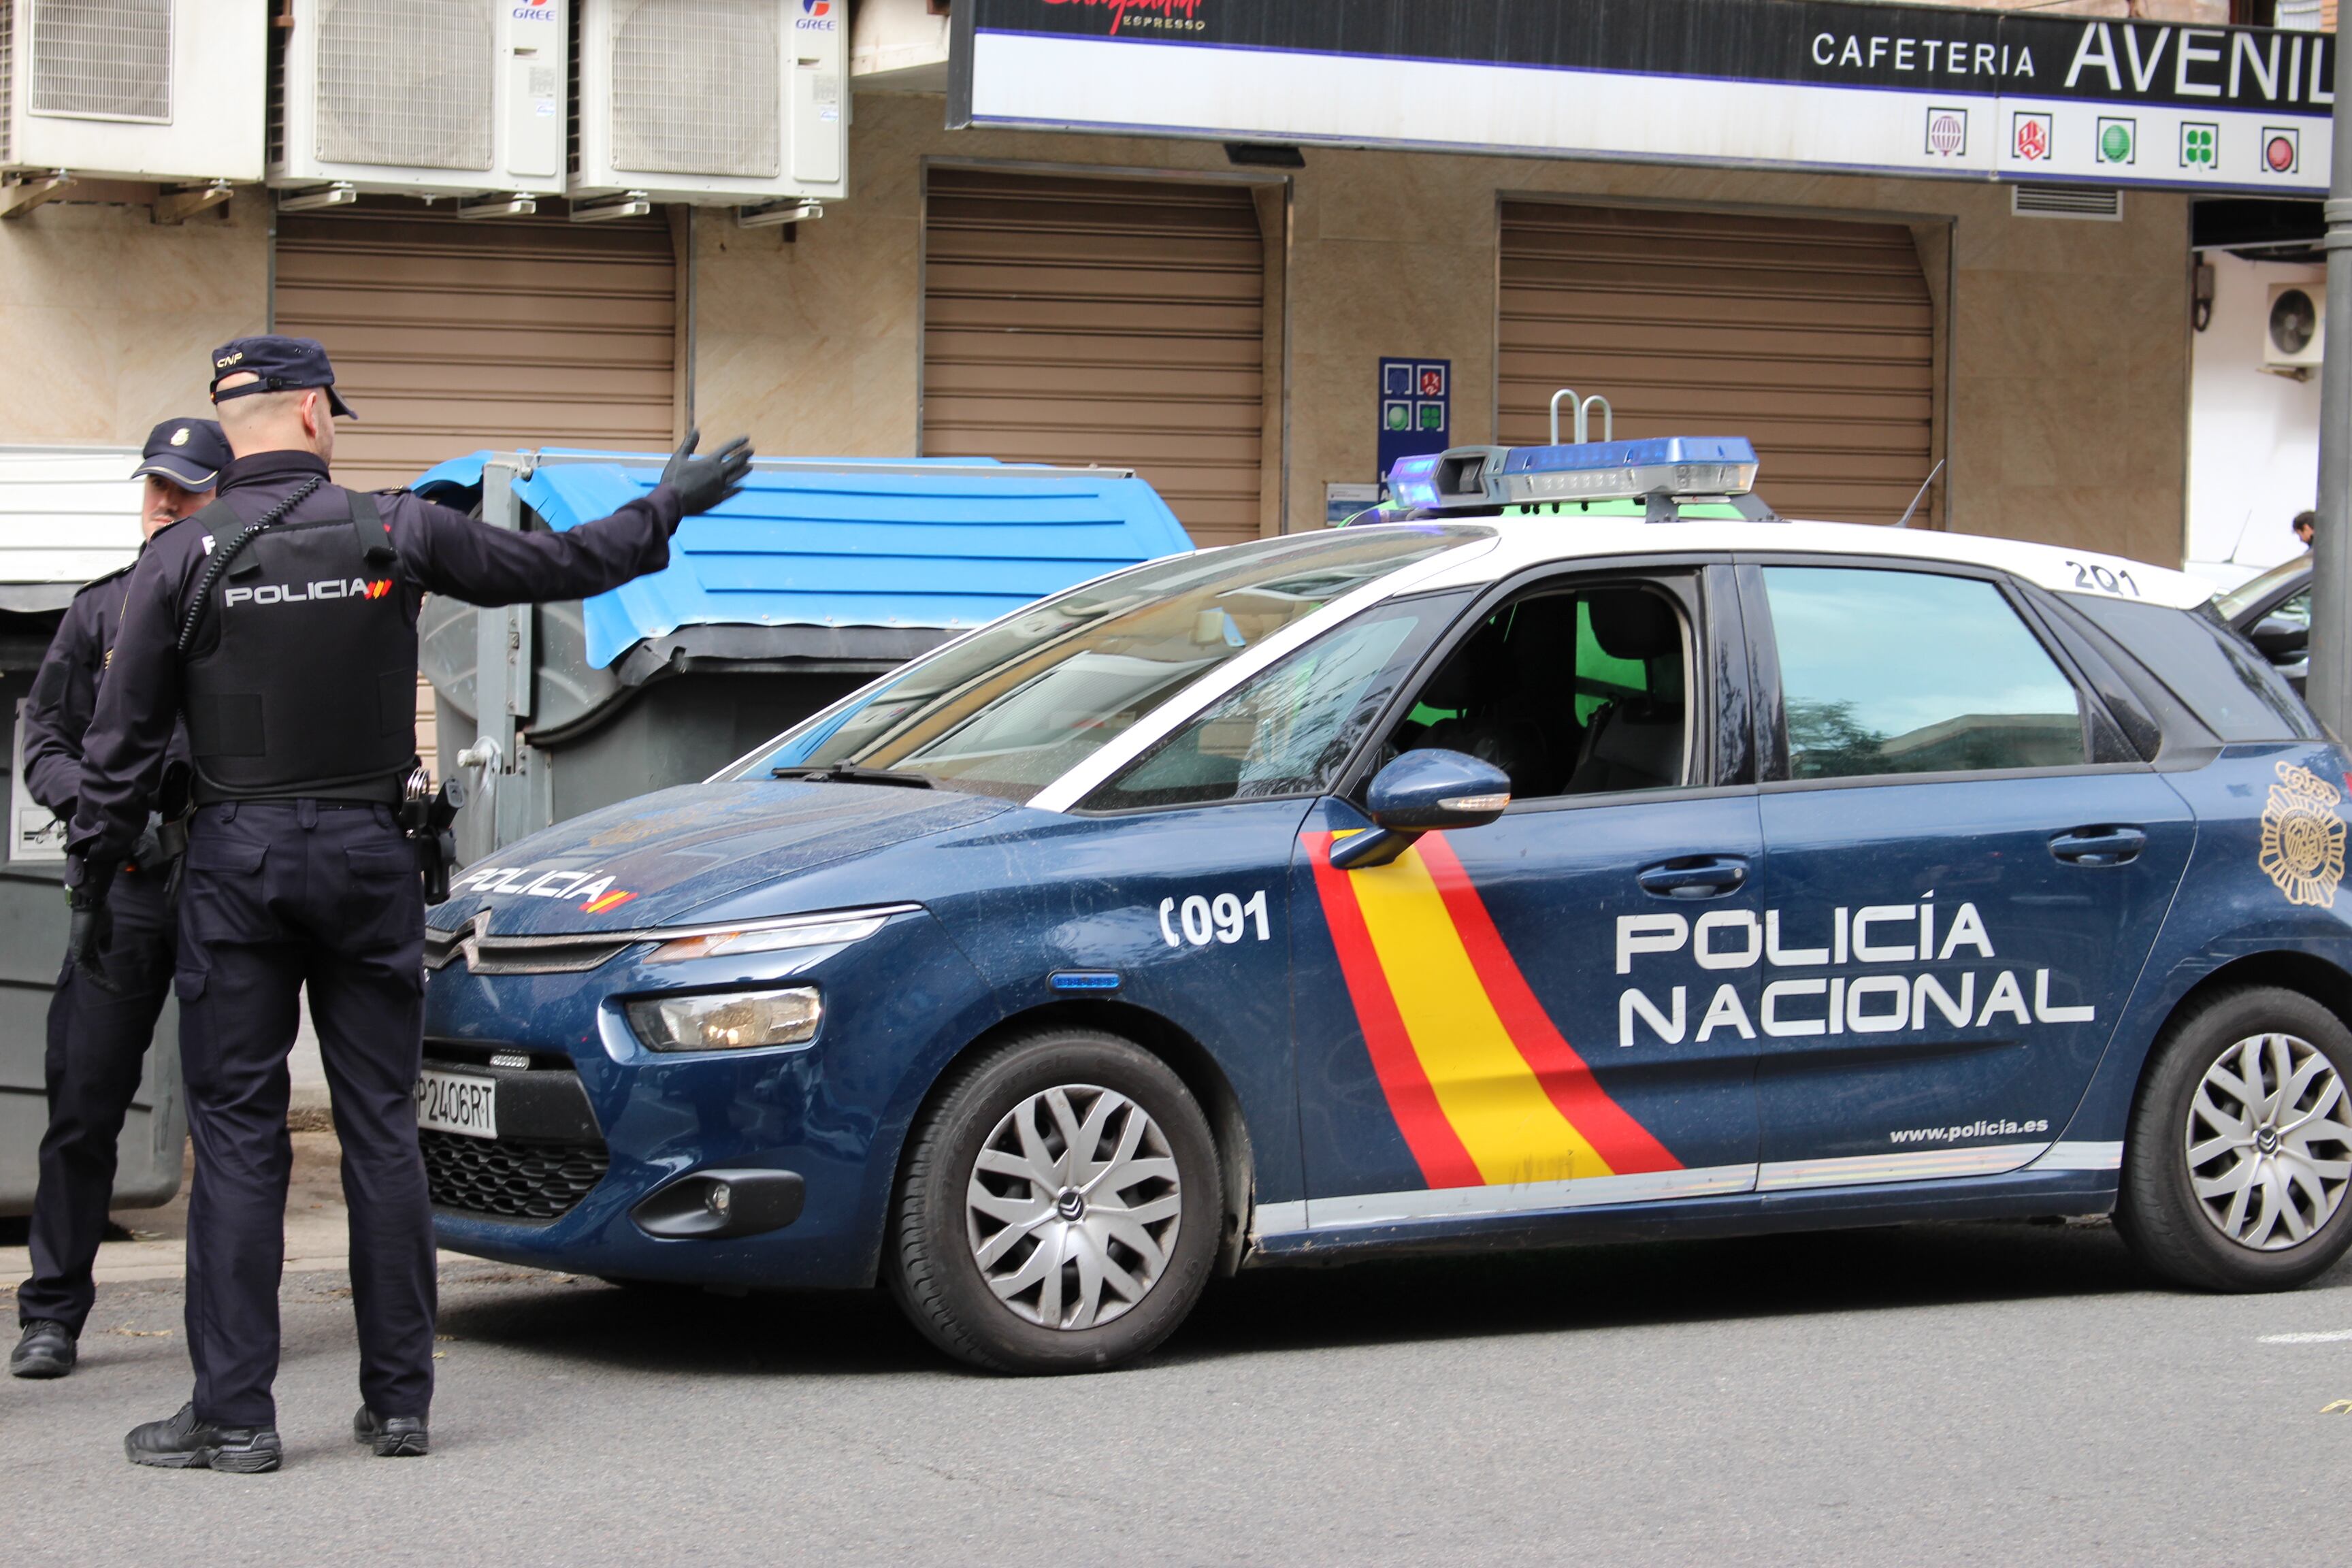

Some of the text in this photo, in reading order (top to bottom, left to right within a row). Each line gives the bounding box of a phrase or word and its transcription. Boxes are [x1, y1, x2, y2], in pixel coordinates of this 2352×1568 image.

[513, 7, 555, 21] GREE
[796, 18, 837, 31] GREE
[1123, 16, 1206, 31] ESPRESSO
[1812, 33, 2035, 78] CAFETERIA
[216, 351, 243, 368] CNP
[225, 577, 370, 608] POLICIA
[1181, 889, 1271, 946] 091
[1615, 888, 1995, 975] POLICÍA
[1618, 968, 2095, 1047] NACIONAL
[413, 1077, 491, 1130] P2406RT
[1890, 1118, 2048, 1143] www.policia.es
